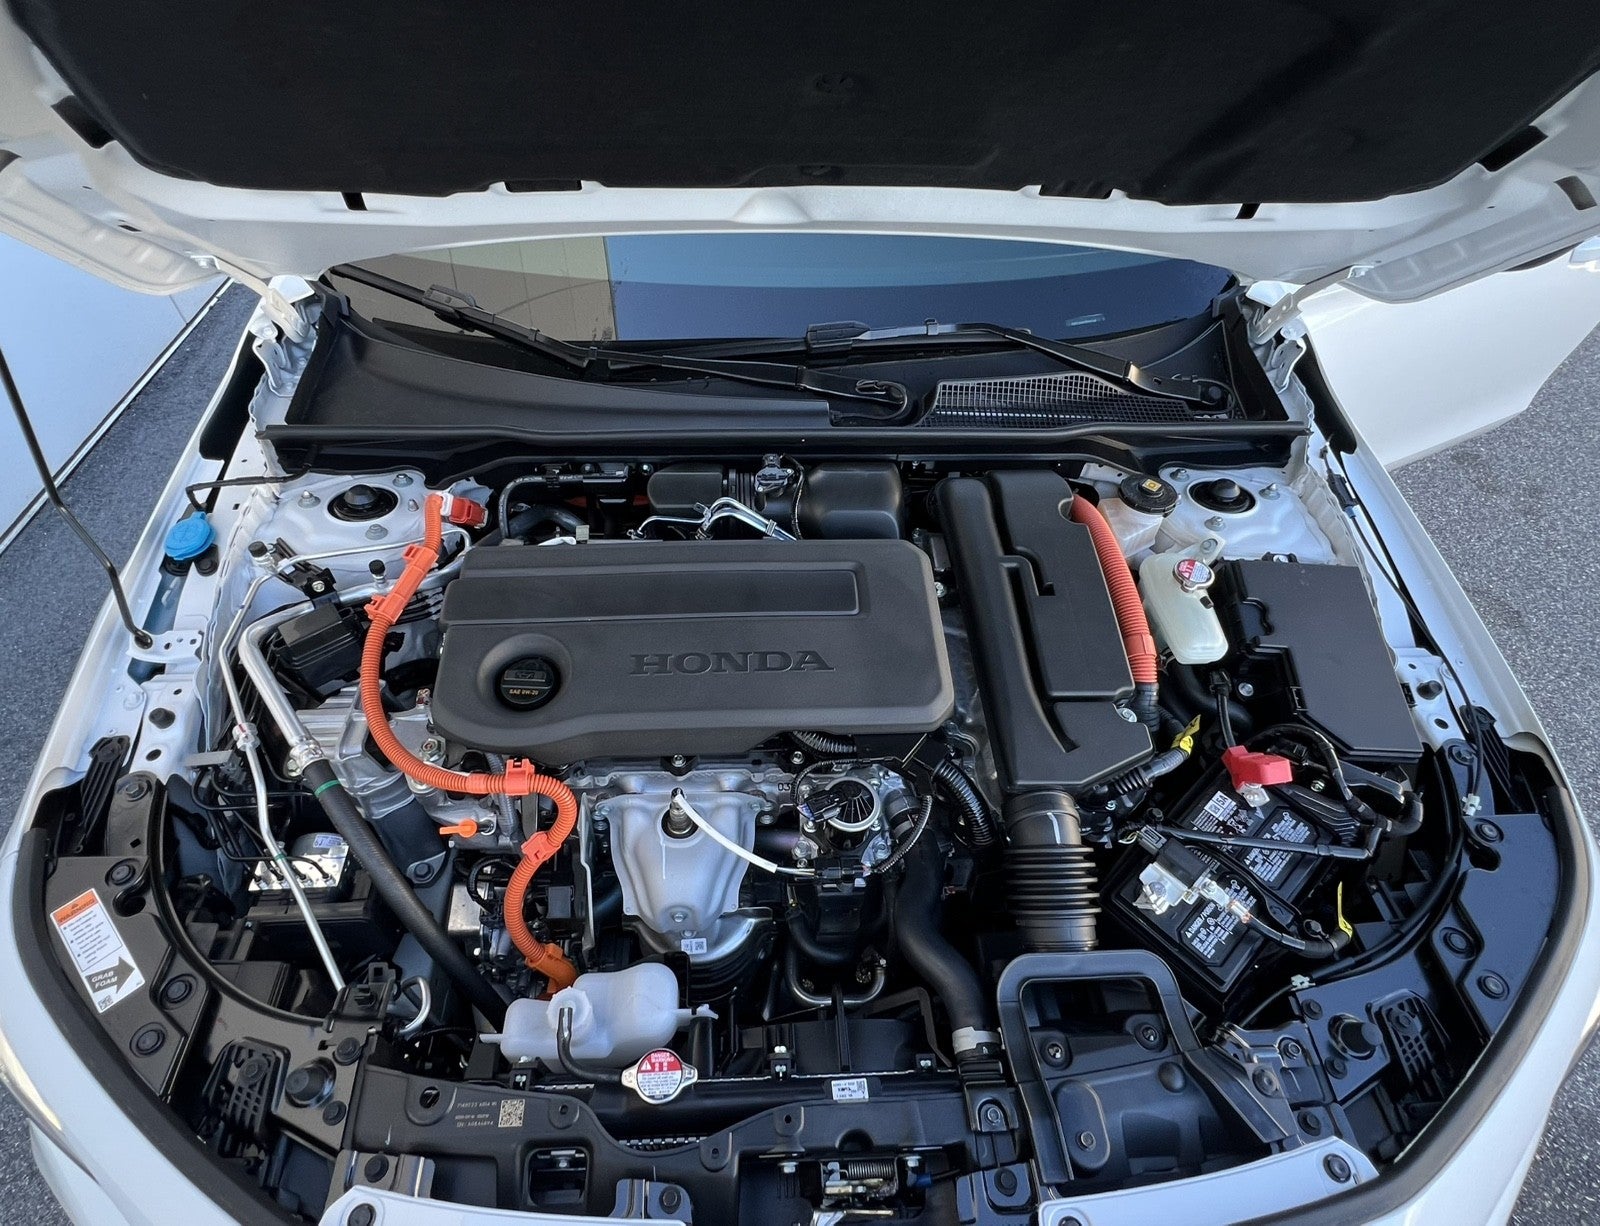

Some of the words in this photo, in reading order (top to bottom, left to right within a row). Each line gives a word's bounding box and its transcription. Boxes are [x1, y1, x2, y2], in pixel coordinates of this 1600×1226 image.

[630, 650, 836, 676] HONDA
[91, 970, 115, 983] GRAB
[94, 976, 118, 989] FOAM
